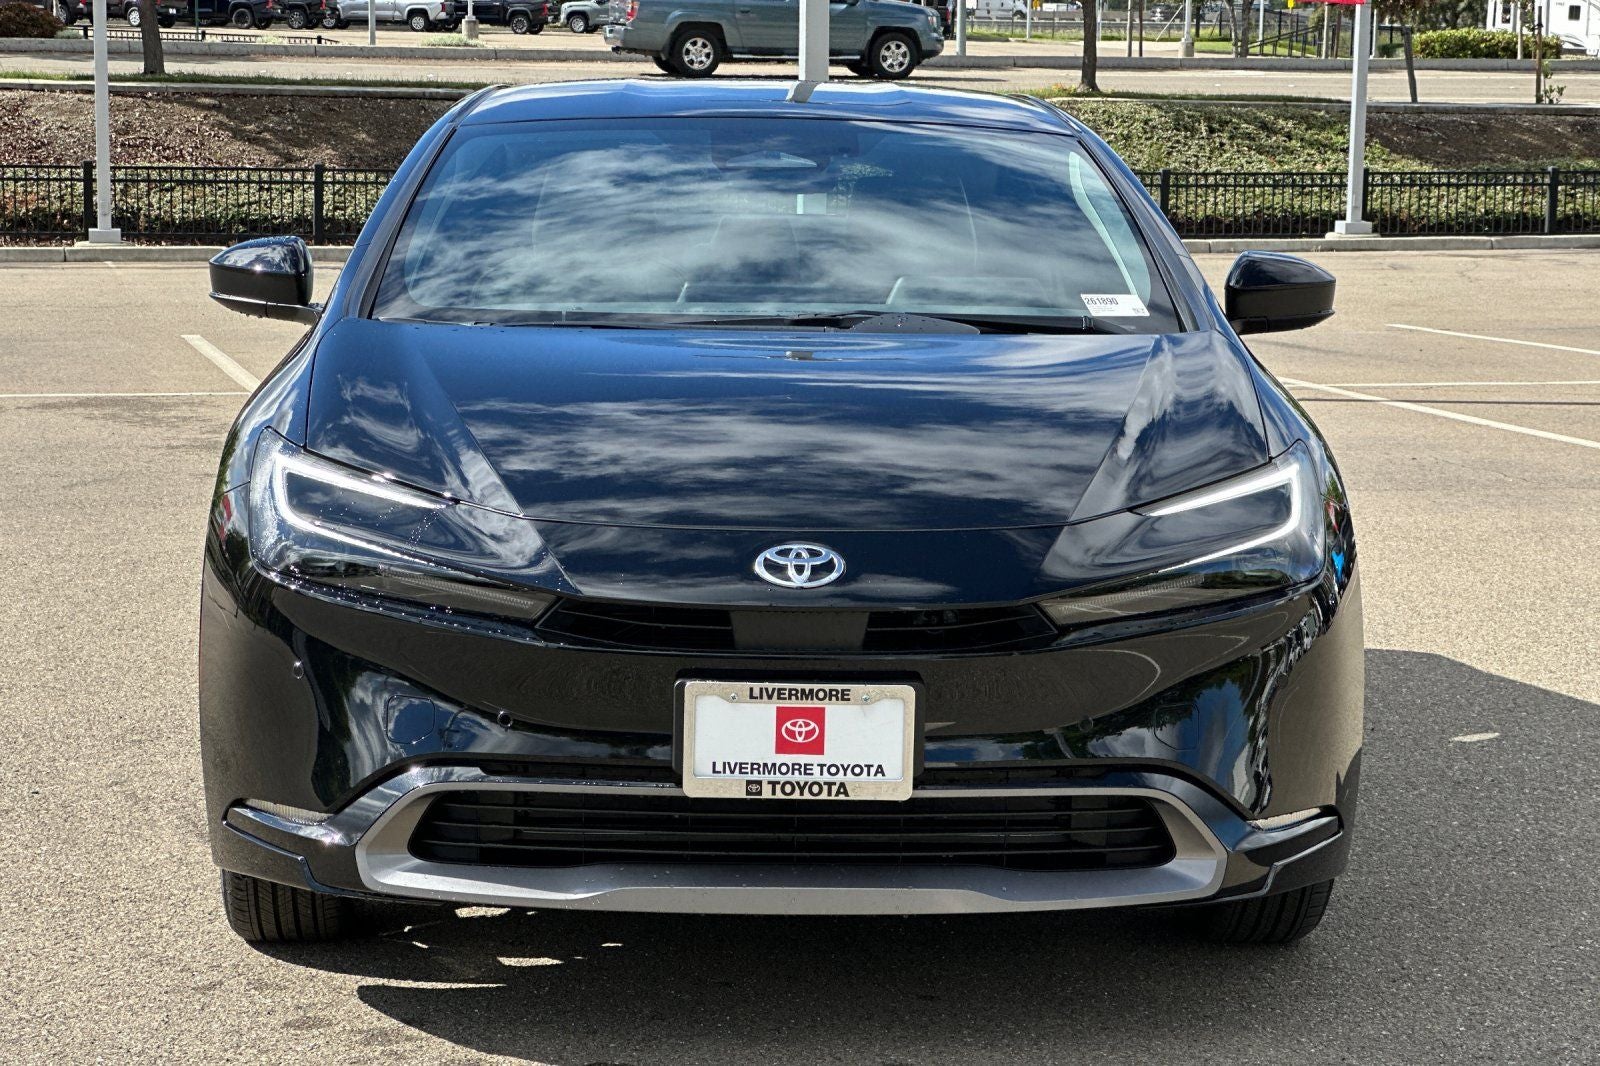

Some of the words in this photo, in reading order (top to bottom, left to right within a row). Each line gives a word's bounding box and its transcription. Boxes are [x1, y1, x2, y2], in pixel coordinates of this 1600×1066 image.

[1084, 297, 1119, 305] 261890
[749, 687, 851, 701] LIVERMORE
[712, 761, 814, 776] LIVERMORE
[817, 763, 886, 777] TOYOTA
[767, 781, 850, 798] TOYOTA
